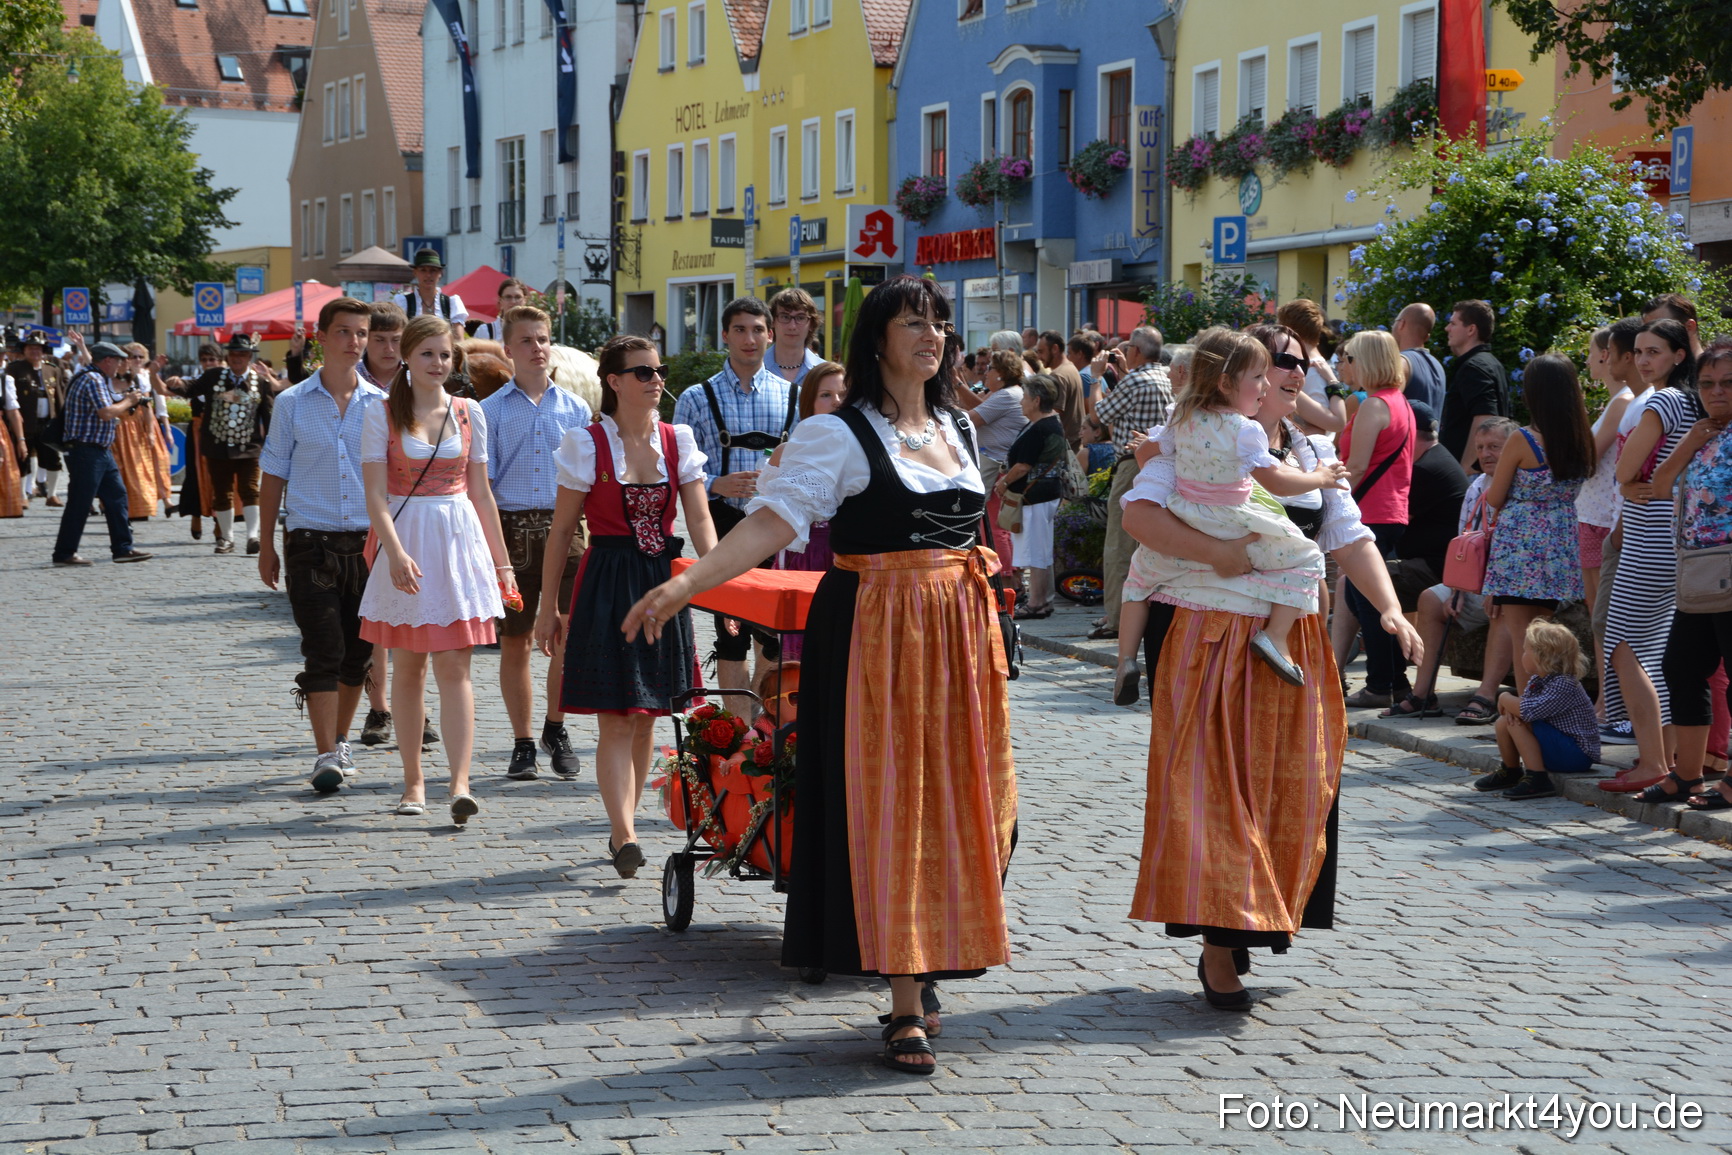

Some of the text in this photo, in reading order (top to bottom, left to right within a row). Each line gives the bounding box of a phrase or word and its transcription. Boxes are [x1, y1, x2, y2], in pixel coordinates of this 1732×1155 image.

[675, 98, 750, 133] HOTEL Lehmeier
[1674, 135, 1688, 185] P
[1139, 131, 1159, 226] WITTL
[746, 192, 753, 222] P
[791, 220, 799, 252] P
[801, 222, 819, 242] FUN
[914, 227, 995, 266] APOTHEKE
[1220, 222, 1239, 259] P
[672, 249, 716, 271] Restaurant
[67, 312, 88, 321] TAXI
[198, 313, 224, 324] TAXI
